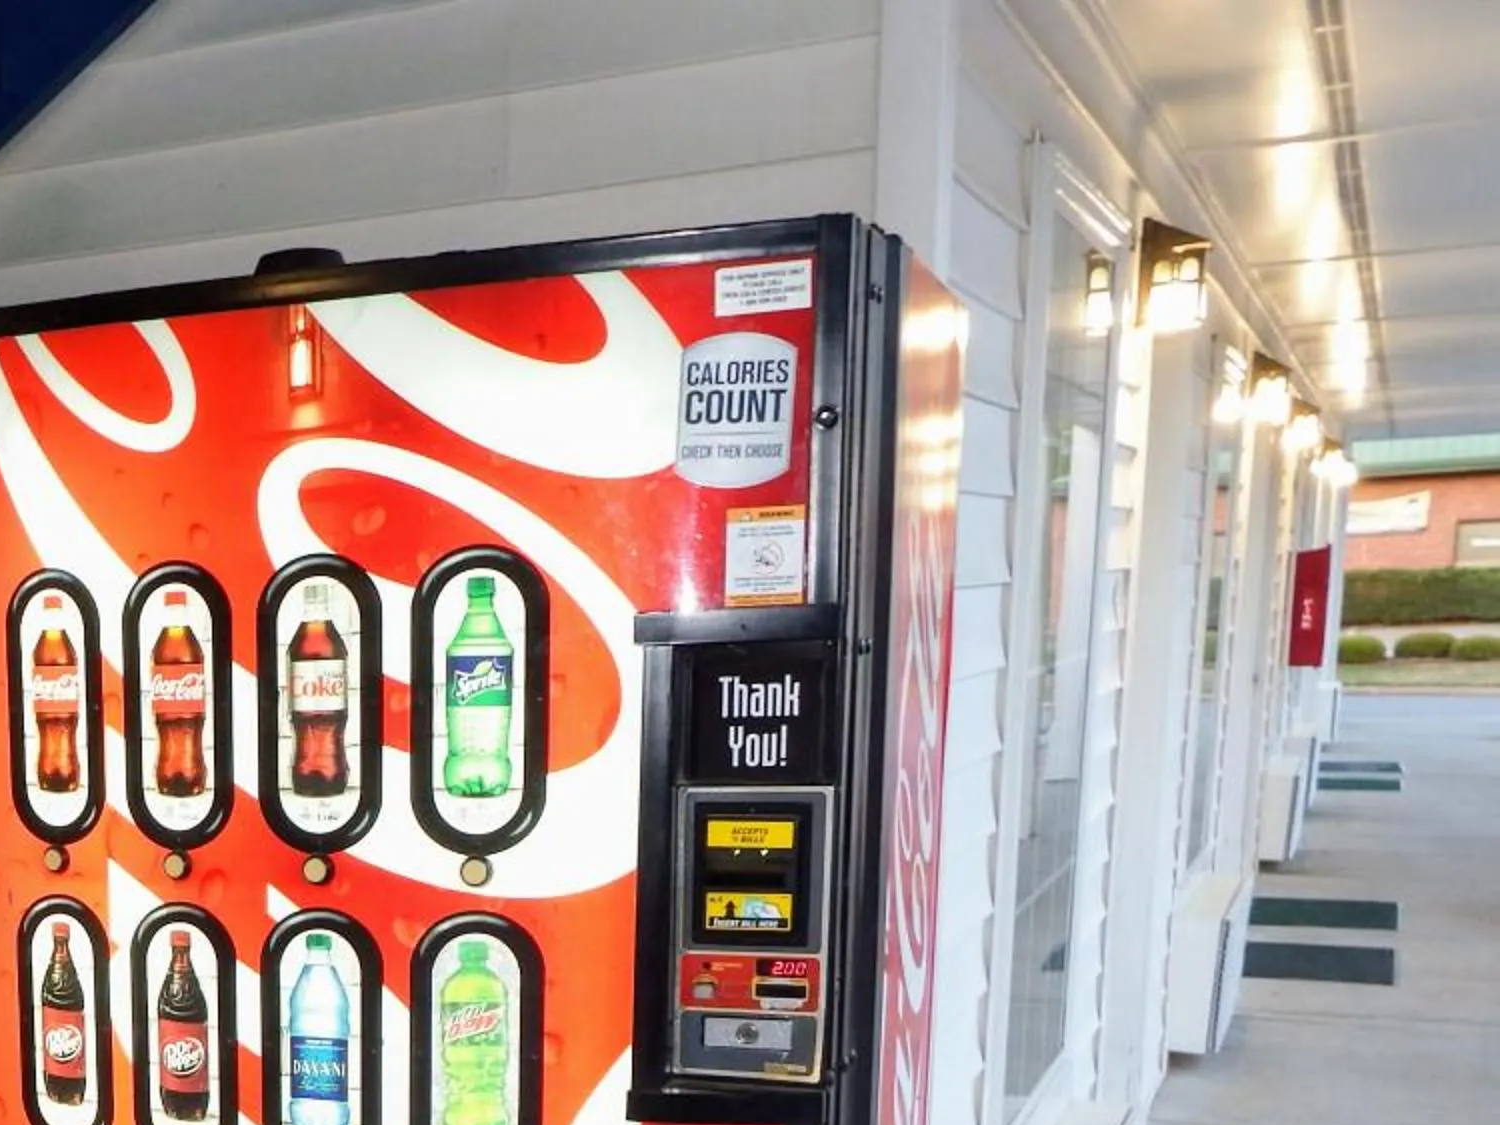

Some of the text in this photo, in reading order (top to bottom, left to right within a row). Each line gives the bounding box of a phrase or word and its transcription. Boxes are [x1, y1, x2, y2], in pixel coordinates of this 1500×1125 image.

[687, 359, 789, 386] CALORIES
[685, 389, 788, 425] COUNT
[681, 445, 713, 459] CHECK
[718, 445, 741, 458] THEN
[290, 675, 344, 699] Coke
[455, 672, 505, 700] Sprite
[718, 674, 801, 719] Thank
[728, 724, 788, 768] You!
[293, 1059, 346, 1078] DASANI
